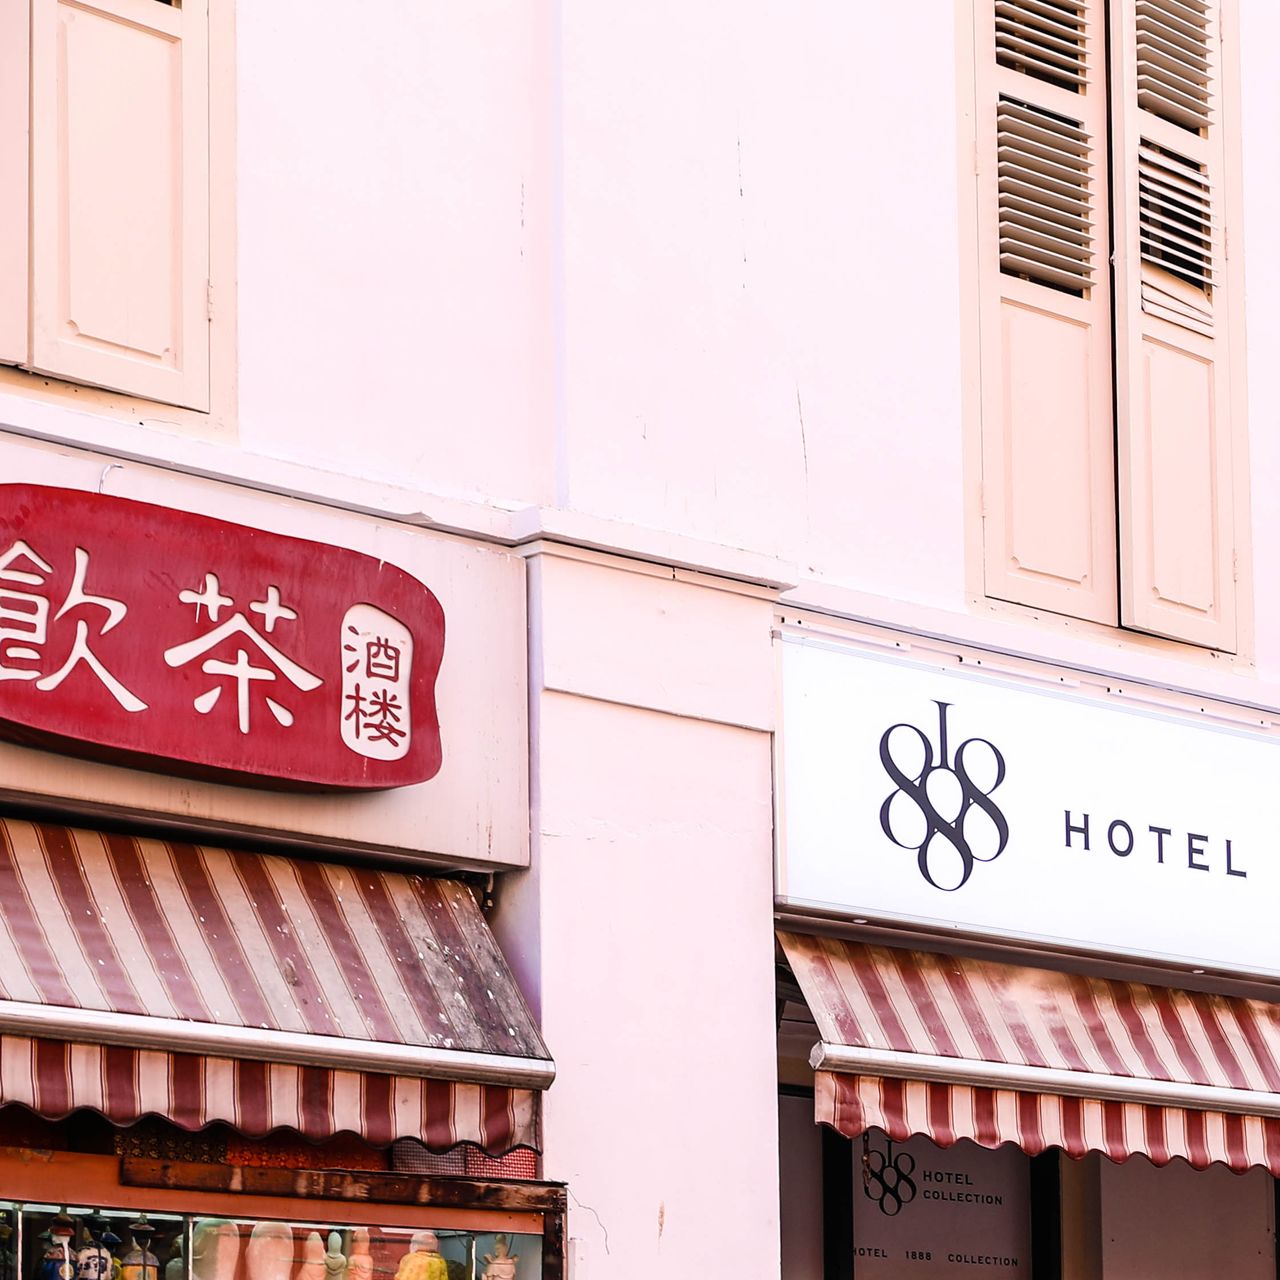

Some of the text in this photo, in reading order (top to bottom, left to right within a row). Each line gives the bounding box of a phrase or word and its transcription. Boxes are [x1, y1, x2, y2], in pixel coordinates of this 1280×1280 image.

[343, 624, 408, 750] 酒楼
[1064, 809, 1248, 879] HOTEL
[922, 1170, 974, 1186] HOTEL
[922, 1190, 1004, 1206] COLLECTION
[905, 1250, 933, 1262] 1888
[947, 1253, 1019, 1267] COLLECTION
